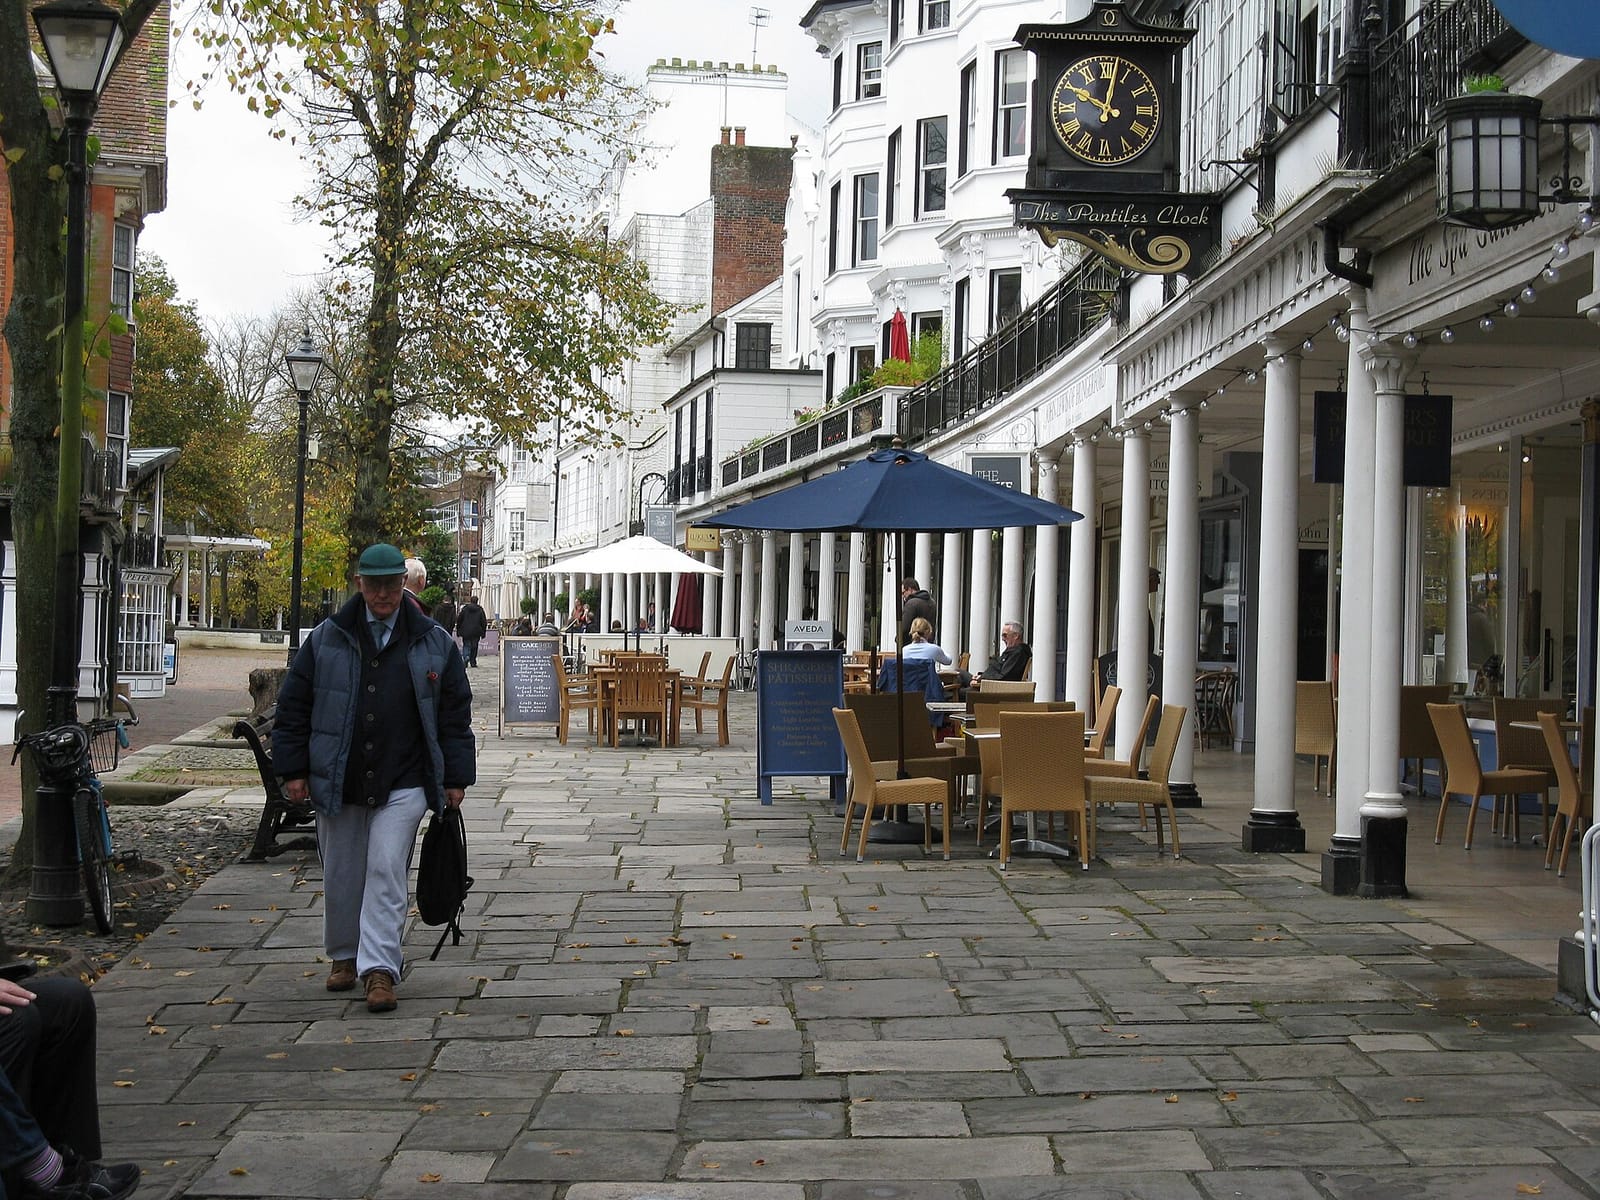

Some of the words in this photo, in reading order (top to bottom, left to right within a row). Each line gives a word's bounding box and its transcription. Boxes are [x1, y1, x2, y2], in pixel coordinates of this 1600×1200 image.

[1019, 202, 1060, 221] The
[1067, 203, 1147, 224] Pantiles
[1157, 206, 1209, 225] Clock
[1408, 236, 1433, 286] The
[976, 469, 999, 482] THE
[126, 573, 151, 583] PETER
[793, 625, 824, 633] AVEDA
